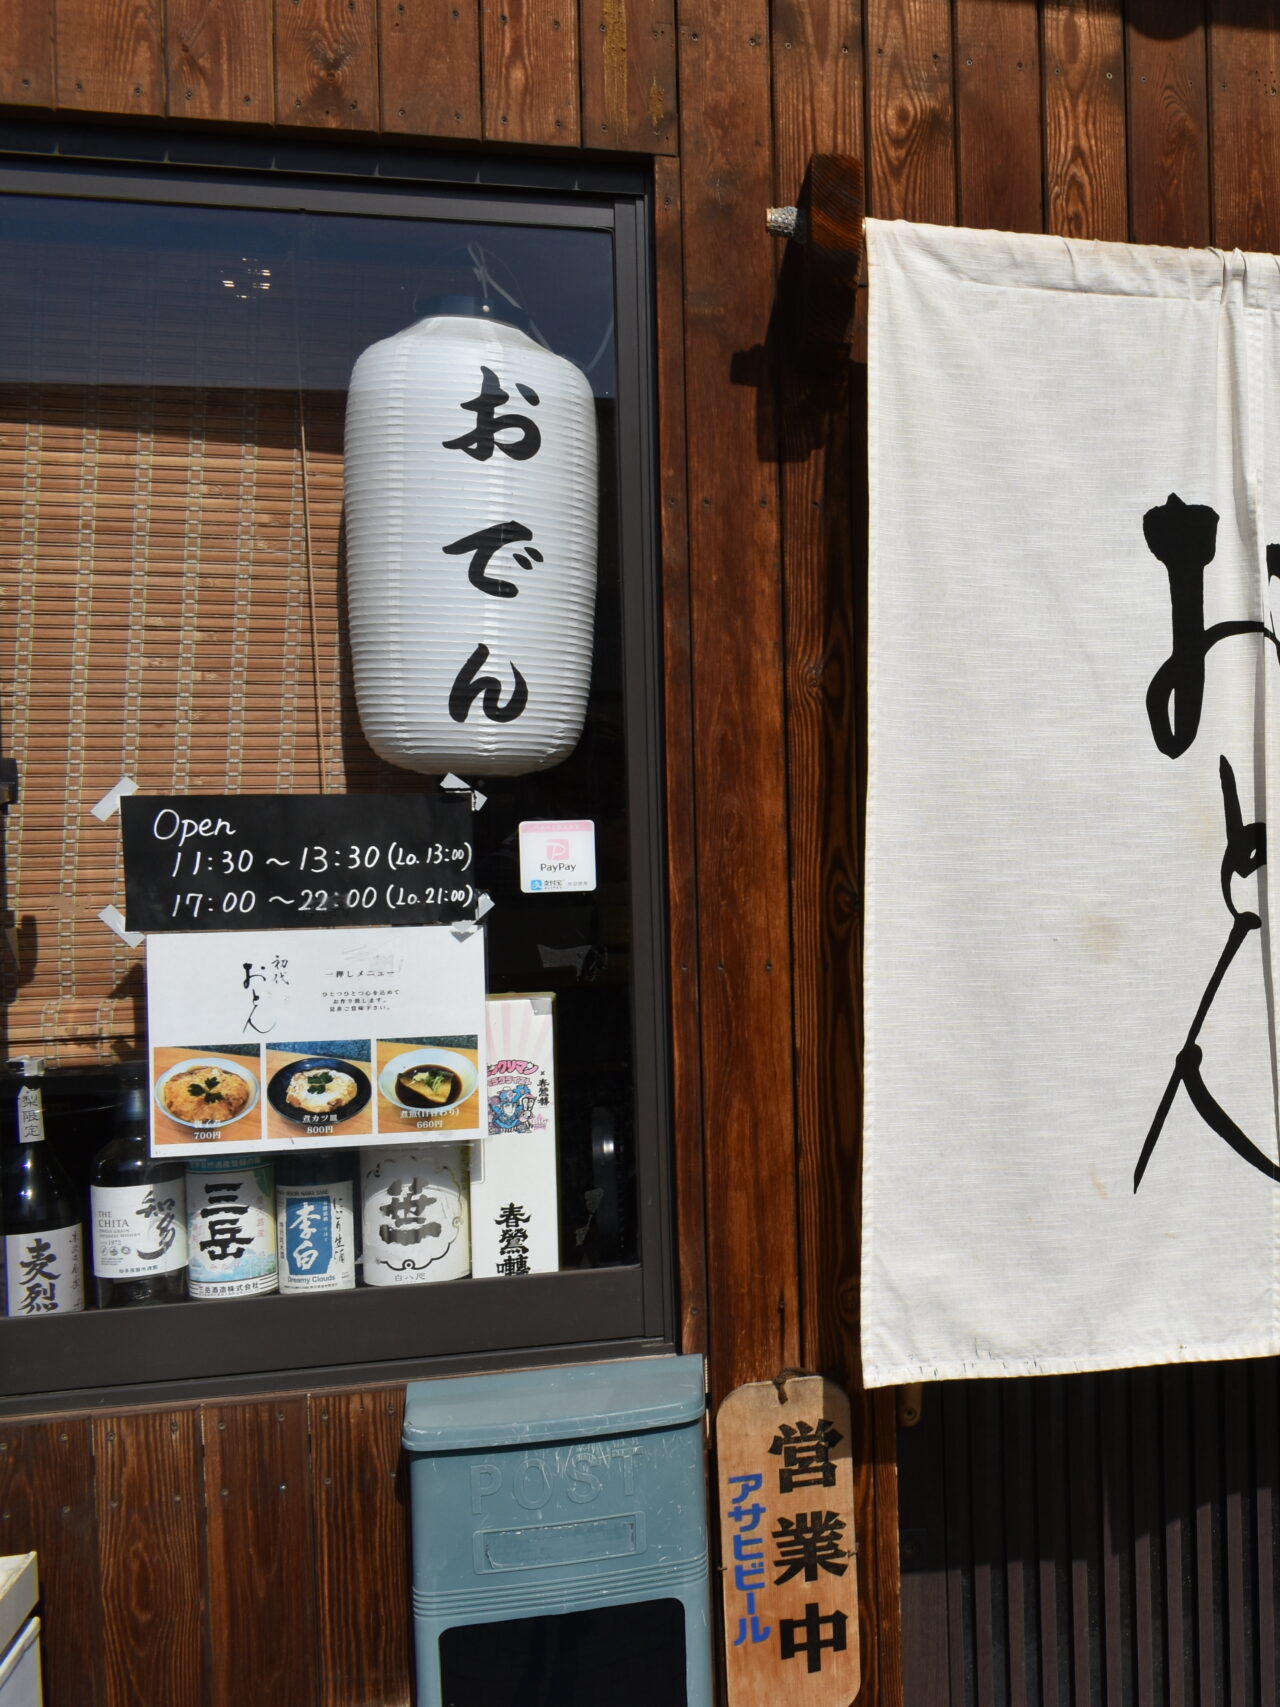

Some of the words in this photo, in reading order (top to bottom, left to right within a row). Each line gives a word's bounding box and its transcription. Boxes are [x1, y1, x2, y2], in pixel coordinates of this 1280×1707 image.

[442, 366, 544, 723] おでん
[153, 809, 236, 847] Open
[172, 850, 253, 878] 11:30
[299, 846, 380, 873] 13:30
[540, 862, 577, 872] PayPay
[172, 890, 256, 918] 17:00
[298, 886, 377, 911] 22:00
[271, 955, 289, 986] 初代
[324, 970, 396, 979] 一押しメニュー
[243, 962, 277, 1034] おとん
[22, 1090, 40, 1138] 梨限定
[306, 1125, 334, 1134] 800円
[416, 1120, 443, 1129] 660円
[193, 1131, 221, 1140] 700円
[98, 1219, 129, 1228] CHITA
[199, 1183, 254, 1261] 三岳
[289, 1202, 321, 1270] 李白
[199, 1281, 259, 1295] 三岳酒造株式会社
[288, 1276, 311, 1285] Dreamy
[312, 1274, 336, 1283] Clouds
[469, 1446, 643, 1515] POST
[728, 1473, 771, 1647] アサヒビール
[768, 1418, 849, 1674] 営業中
